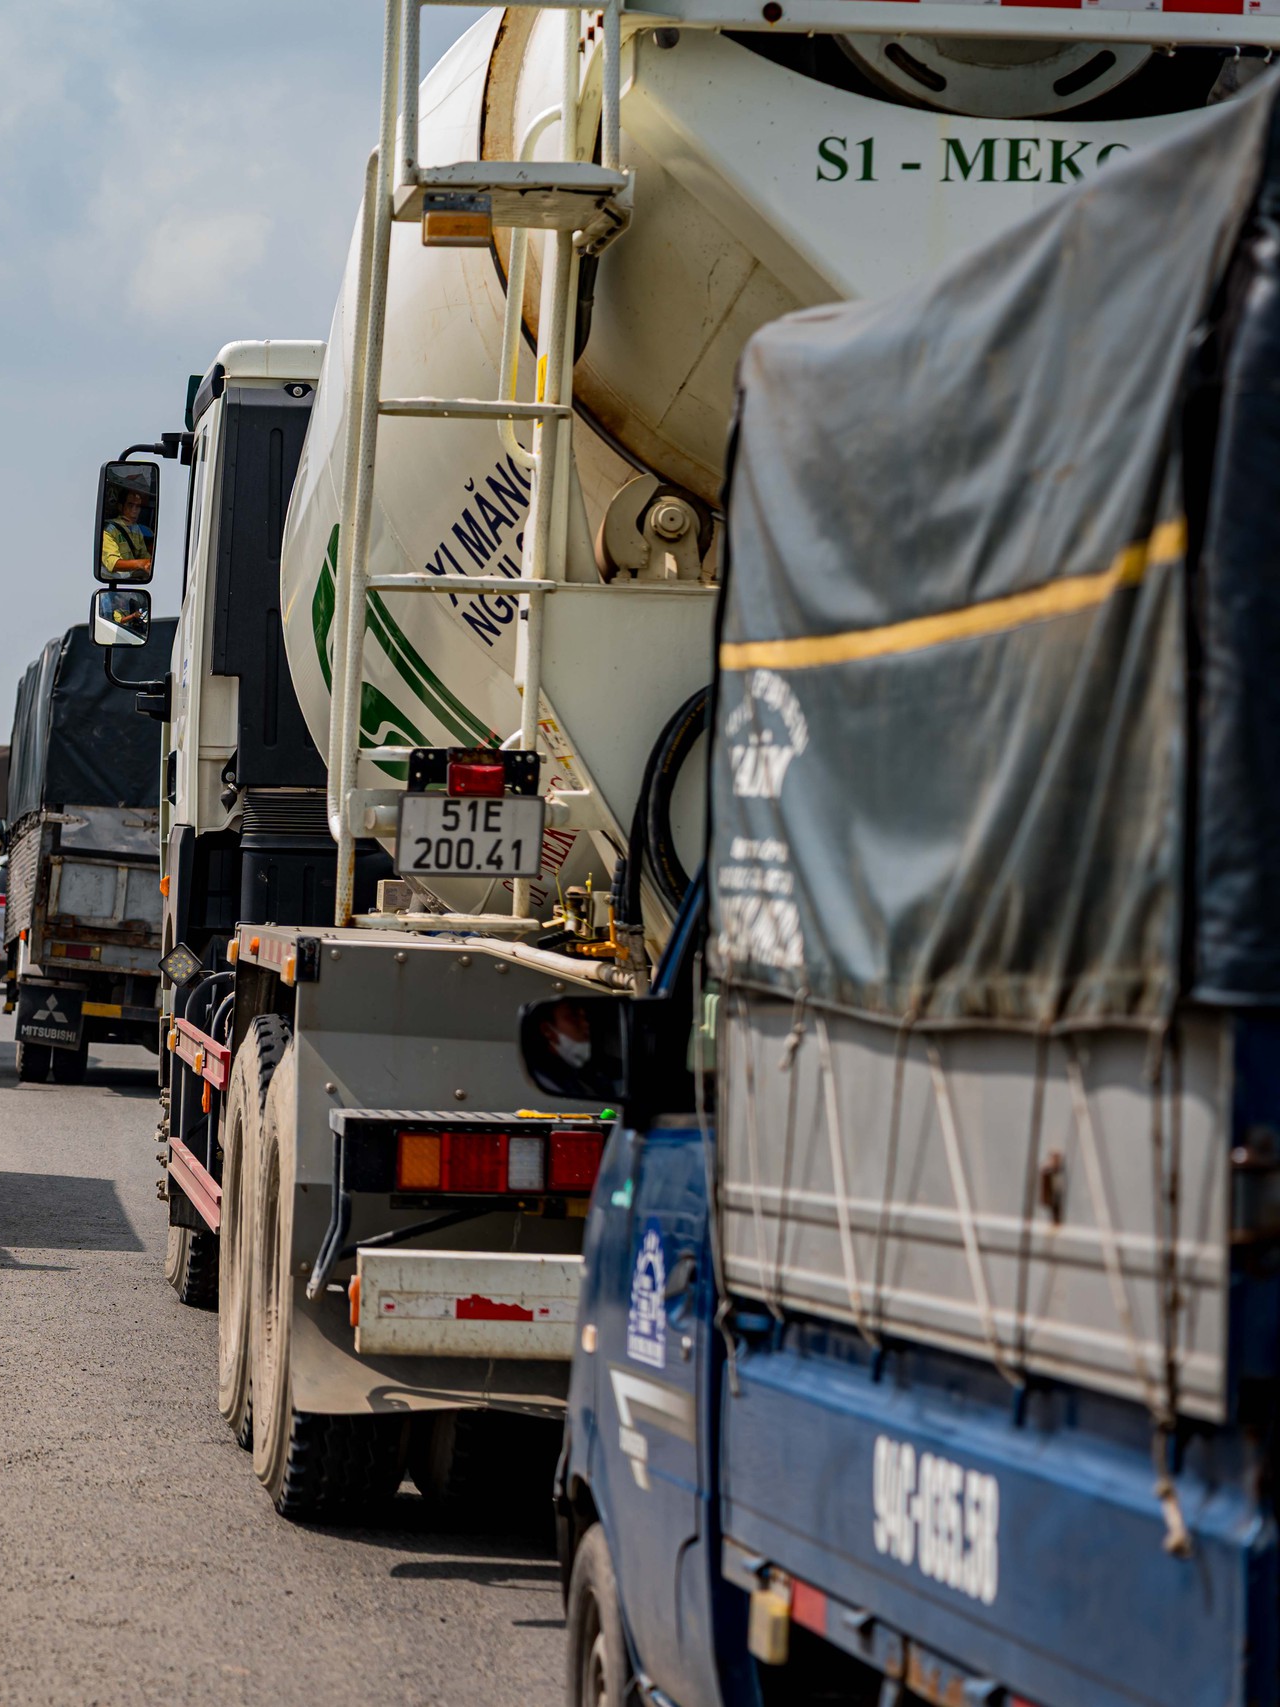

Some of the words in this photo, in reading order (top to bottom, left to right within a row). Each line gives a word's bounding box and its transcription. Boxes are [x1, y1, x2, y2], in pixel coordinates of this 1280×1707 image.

[816, 136, 879, 182] S1
[442, 800, 503, 832] 51E
[413, 837, 522, 871] 200.41
[21, 1024, 77, 1042] MITSUBISHI
